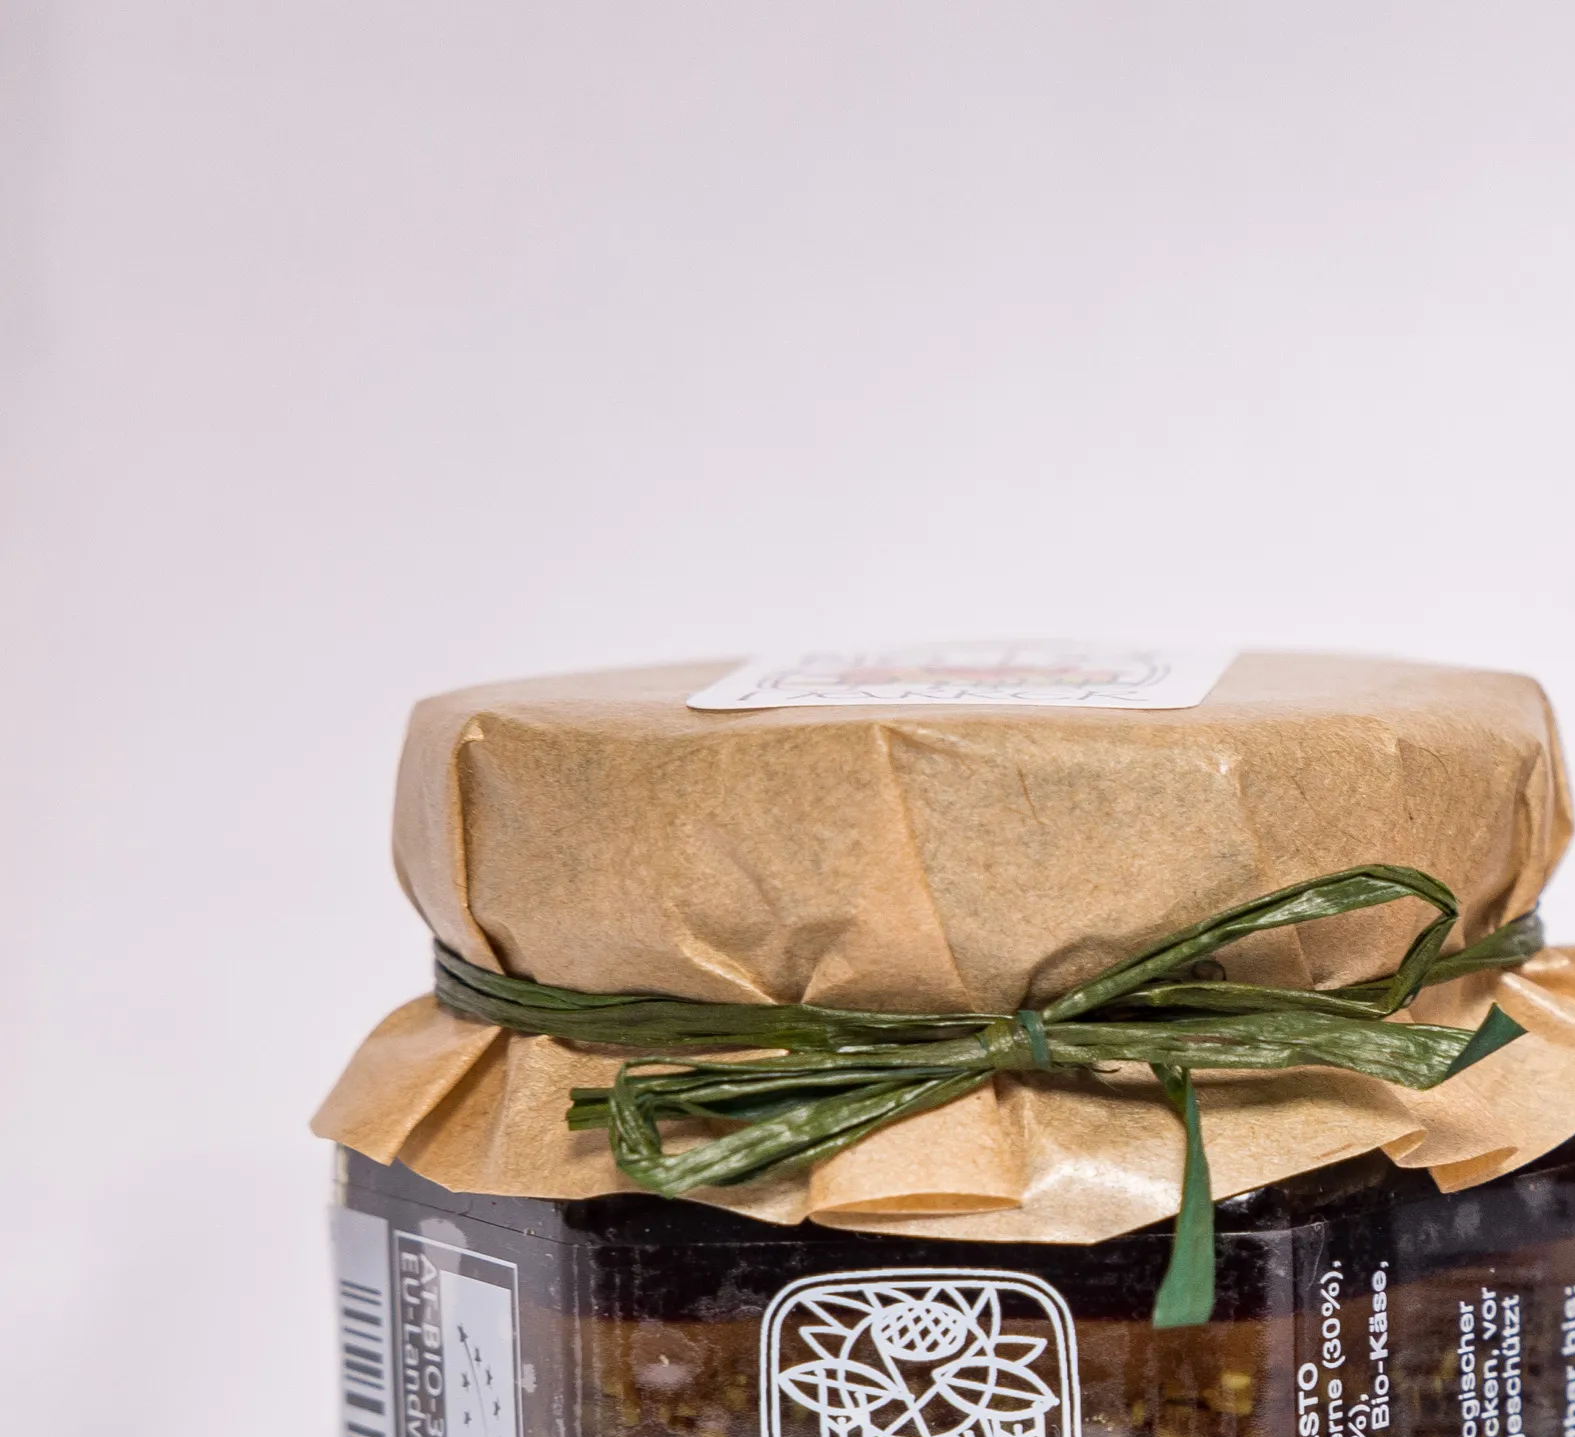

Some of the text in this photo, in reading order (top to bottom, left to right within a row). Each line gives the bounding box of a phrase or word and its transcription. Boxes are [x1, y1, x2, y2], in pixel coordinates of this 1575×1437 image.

[1320, 1259, 1346, 1368] (30%),
[1368, 1260, 1391, 1429] Bio-Käse,
[1481, 1287, 1498, 1339] vor
